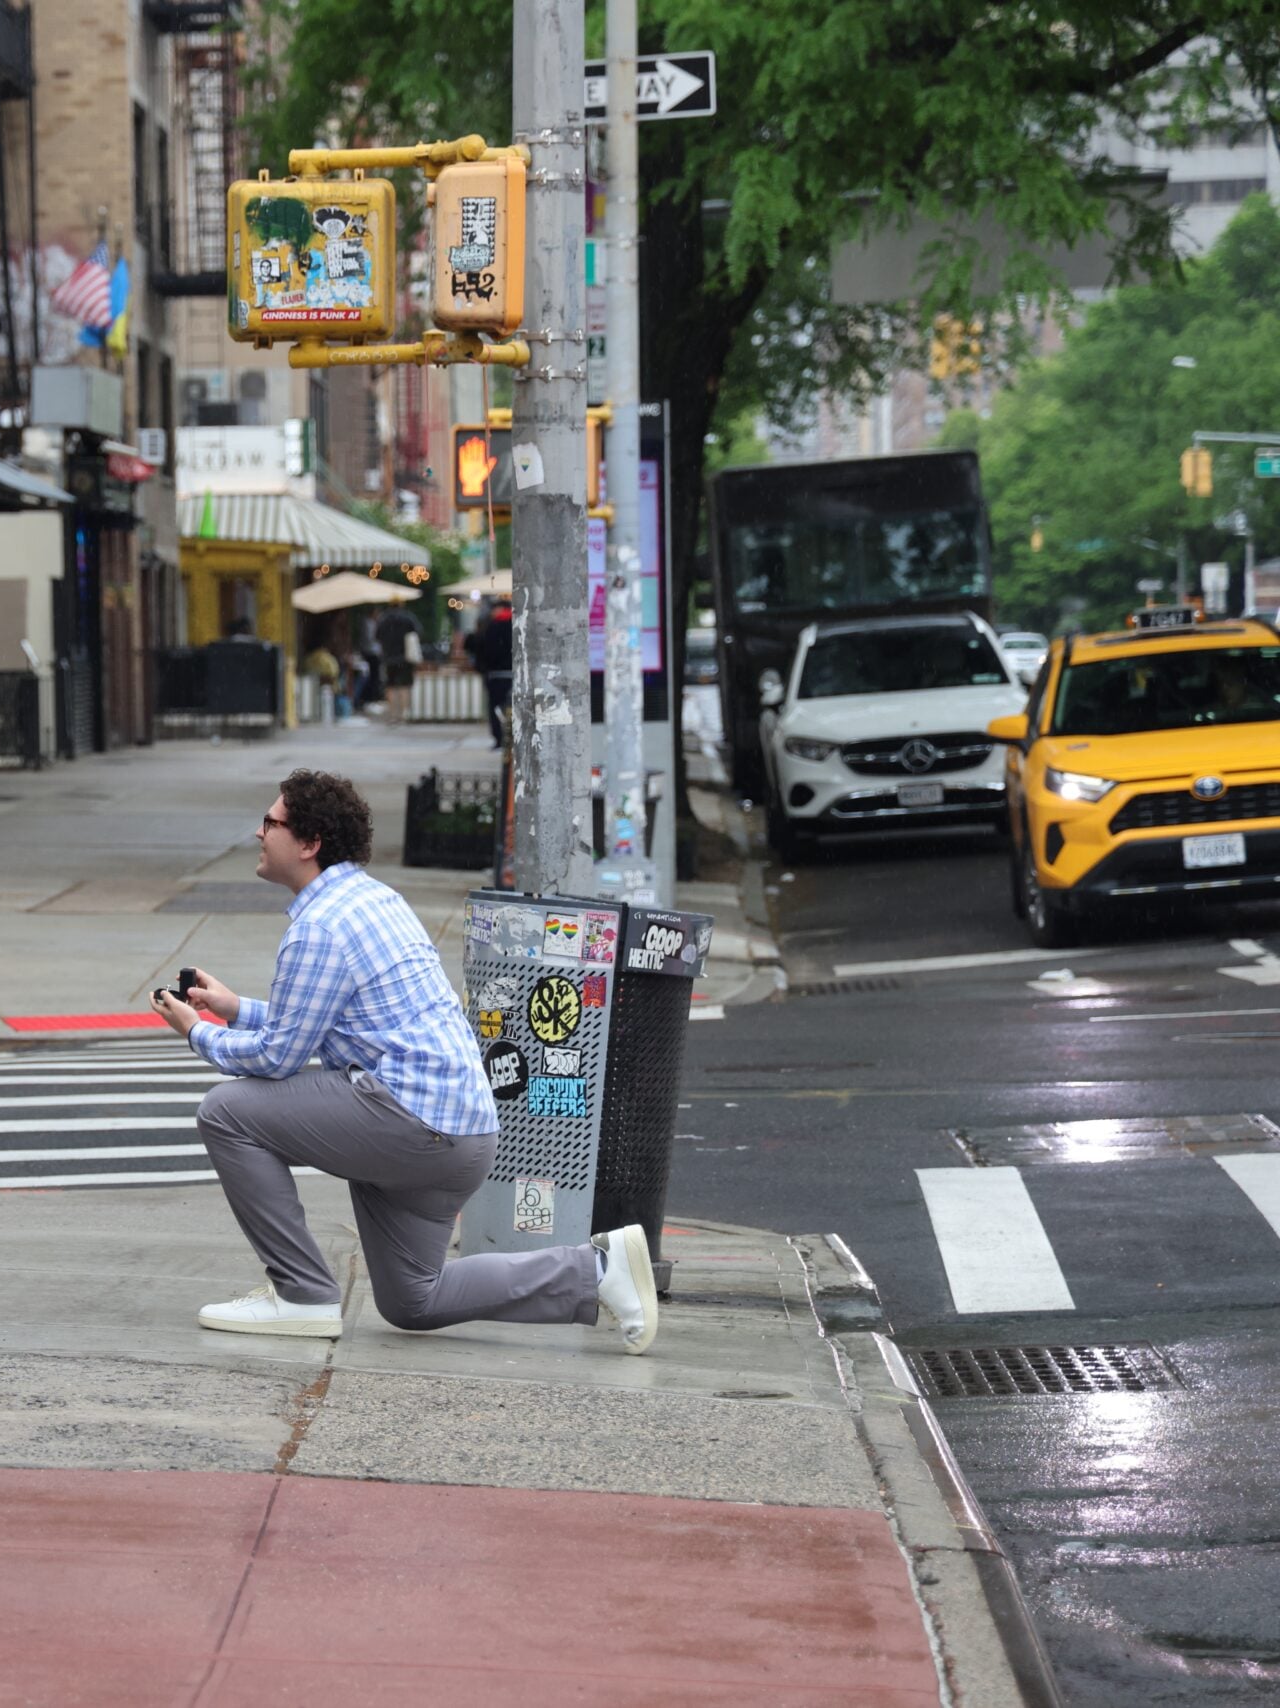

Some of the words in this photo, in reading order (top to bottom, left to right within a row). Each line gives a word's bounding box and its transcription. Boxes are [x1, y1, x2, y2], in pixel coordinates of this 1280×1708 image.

[637, 75, 674, 99] AY
[262, 310, 307, 321] KINDNESS
[309, 311, 318, 320] IS
[320, 311, 346, 321] PUNK
[348, 311, 360, 320] AF
[528, 1077, 587, 1098] DISCOUNT
